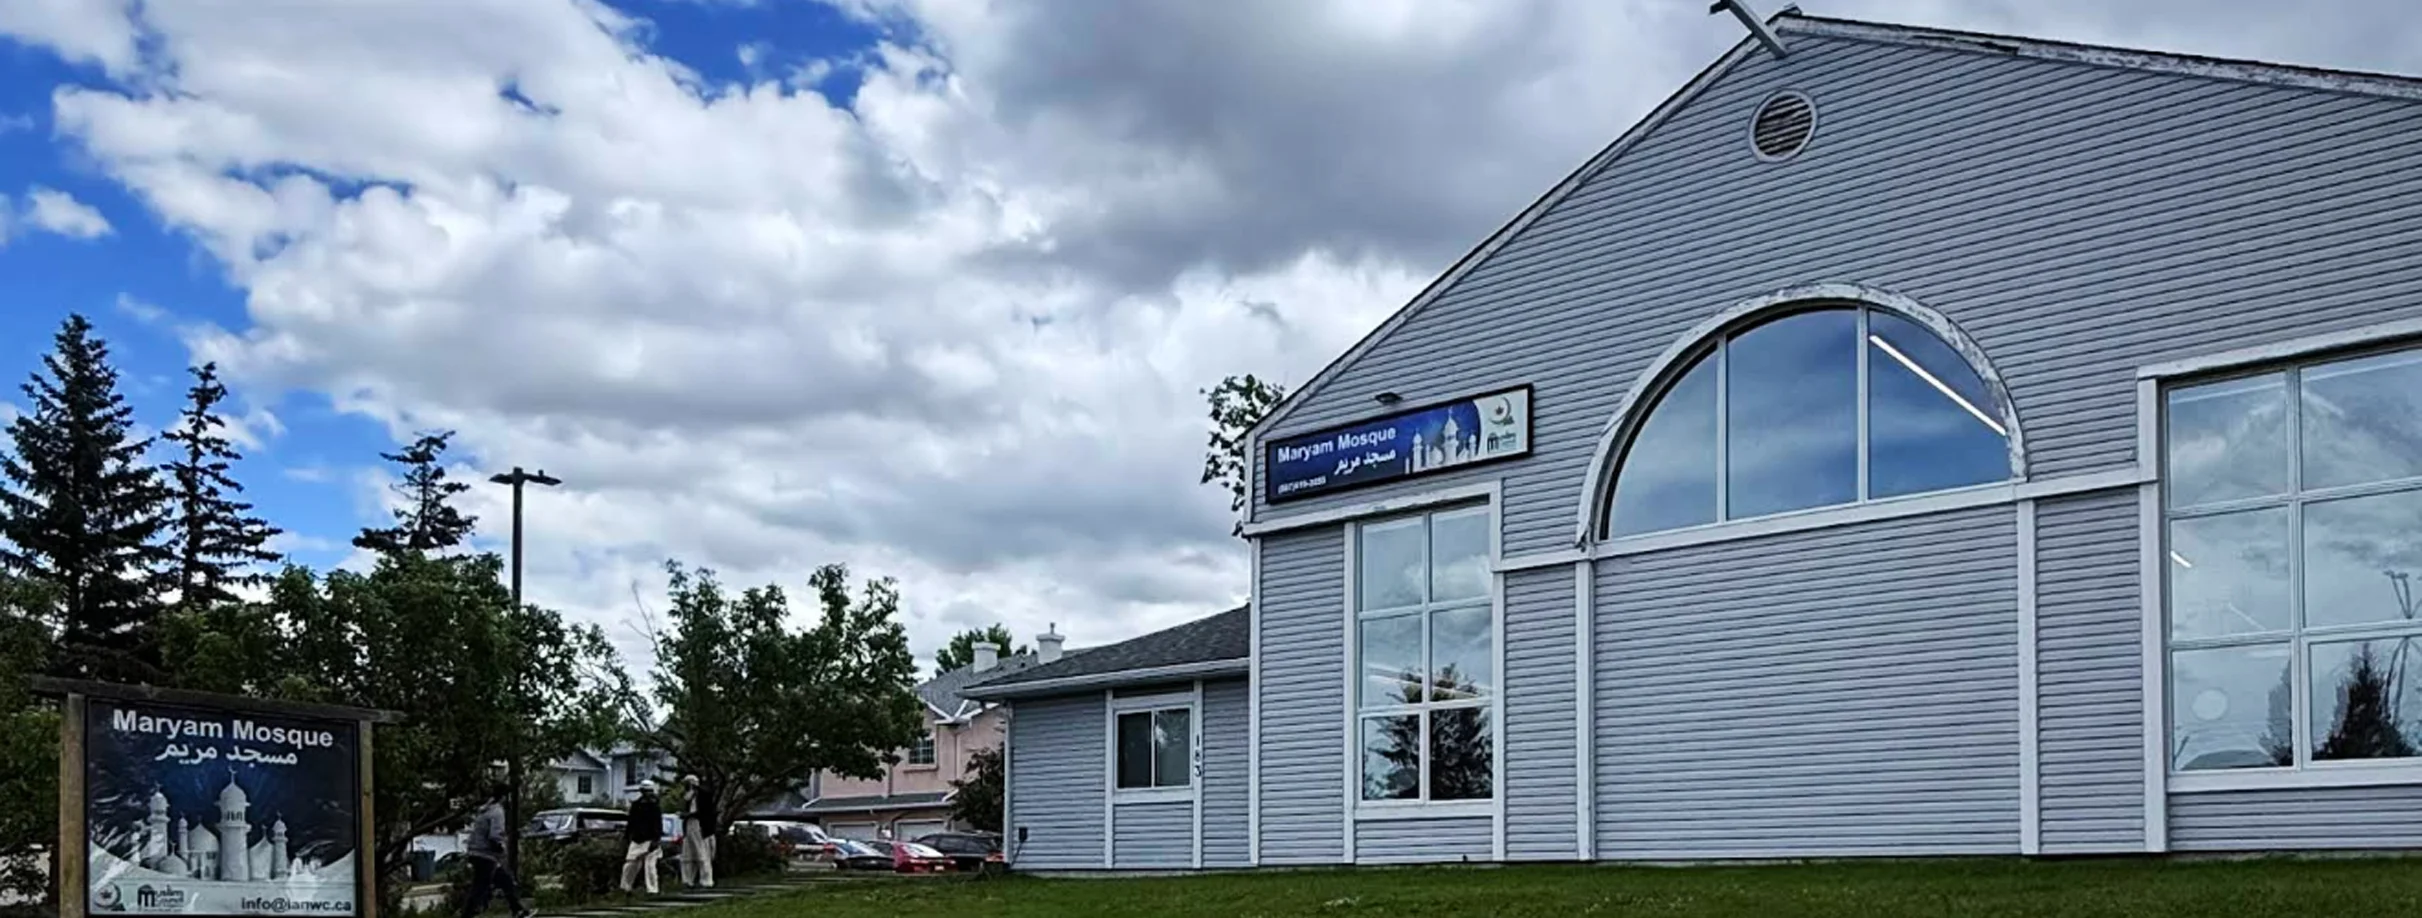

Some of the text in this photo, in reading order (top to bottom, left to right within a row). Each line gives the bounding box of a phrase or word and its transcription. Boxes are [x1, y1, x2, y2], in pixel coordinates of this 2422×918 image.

[1278, 427, 1397, 463] Maryam Mosque
[1363, 449, 1397, 468] مسجد
[113, 708, 334, 749] Maryam Mosque
[155, 743, 299, 768] مسجد مريم
[1194, 733, 1202, 778] 183
